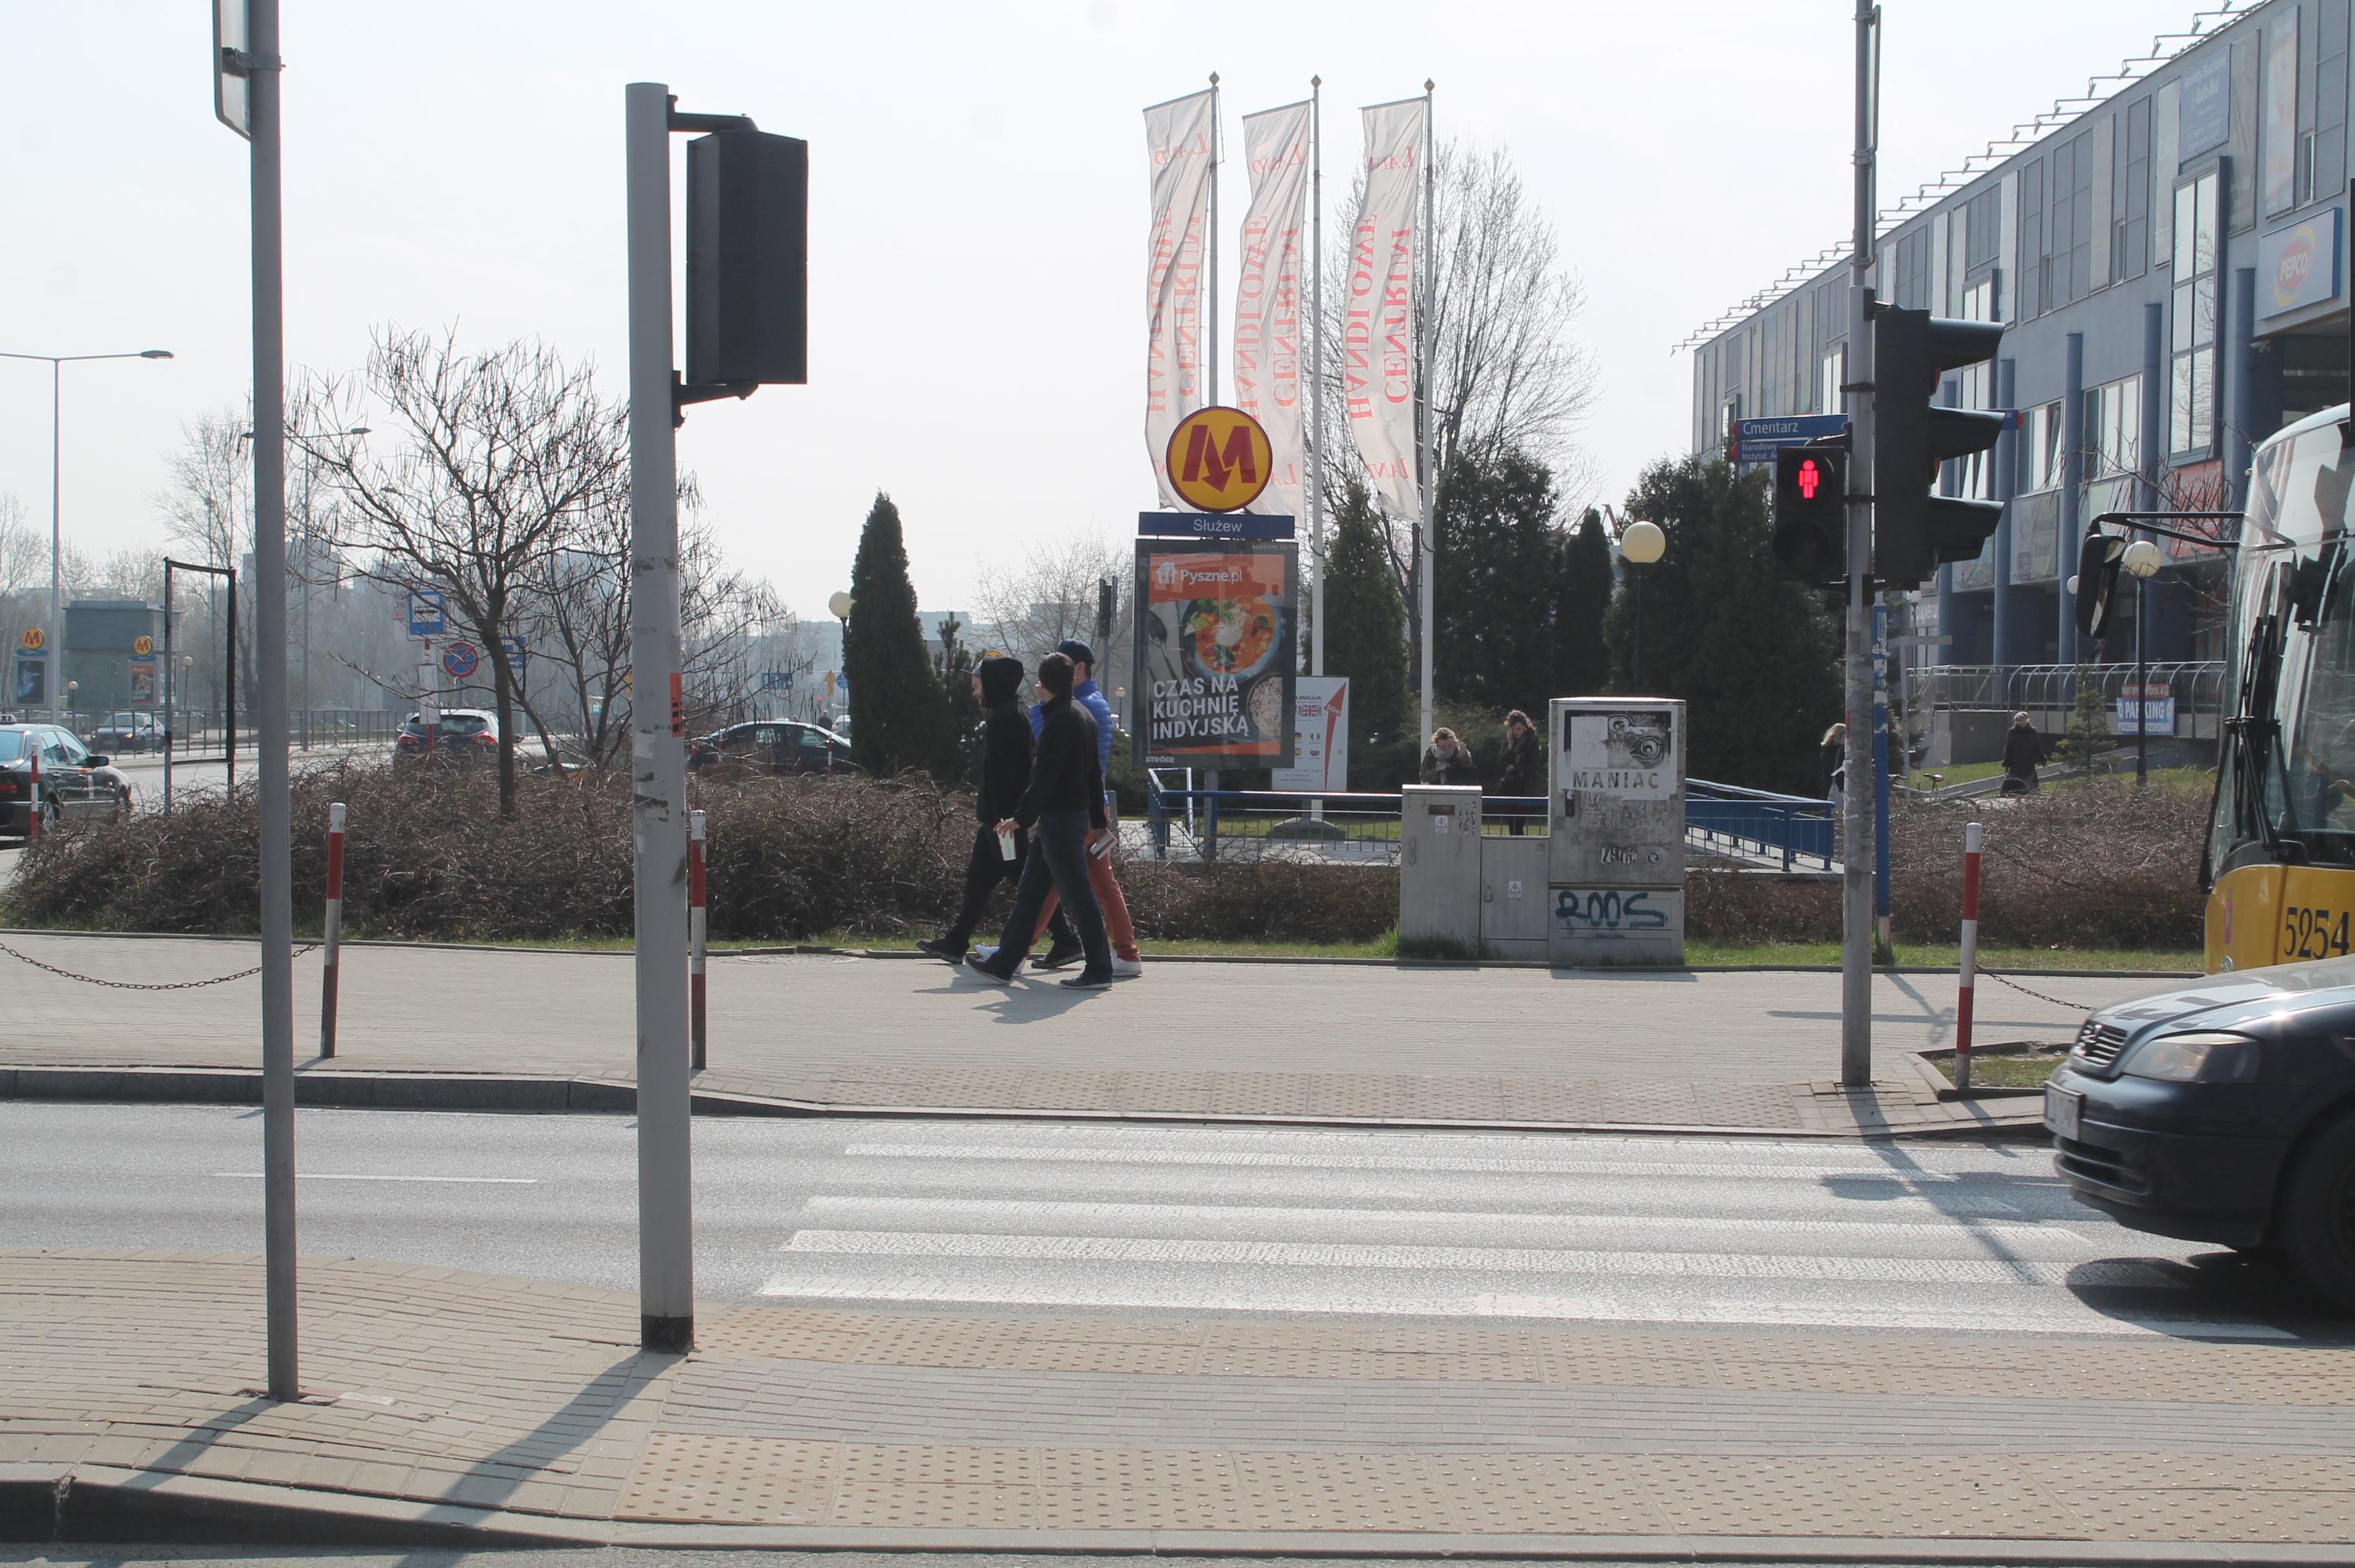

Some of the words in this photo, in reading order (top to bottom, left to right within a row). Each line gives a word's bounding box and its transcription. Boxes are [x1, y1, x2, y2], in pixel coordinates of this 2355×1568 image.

[2280, 251, 2308, 281] PEPCO
[1743, 422, 1798, 435] Cmentarz
[1742, 443, 1777, 452] Narodowy
[1742, 452, 1767, 461] Instytut
[1193, 519, 1242, 532] Służew
[1181, 570, 1242, 586] Pyszne.pl
[1153, 677, 1205, 699] CZAS
[1211, 676, 1239, 693] NA
[1153, 696, 1239, 717] KUCHNIĘ
[1326, 704, 1341, 717] 50m
[1153, 715, 1249, 740] INDYJSKĄ
[1573, 771, 1659, 790] MANIAC
[2284, 906, 2350, 959] 5254
